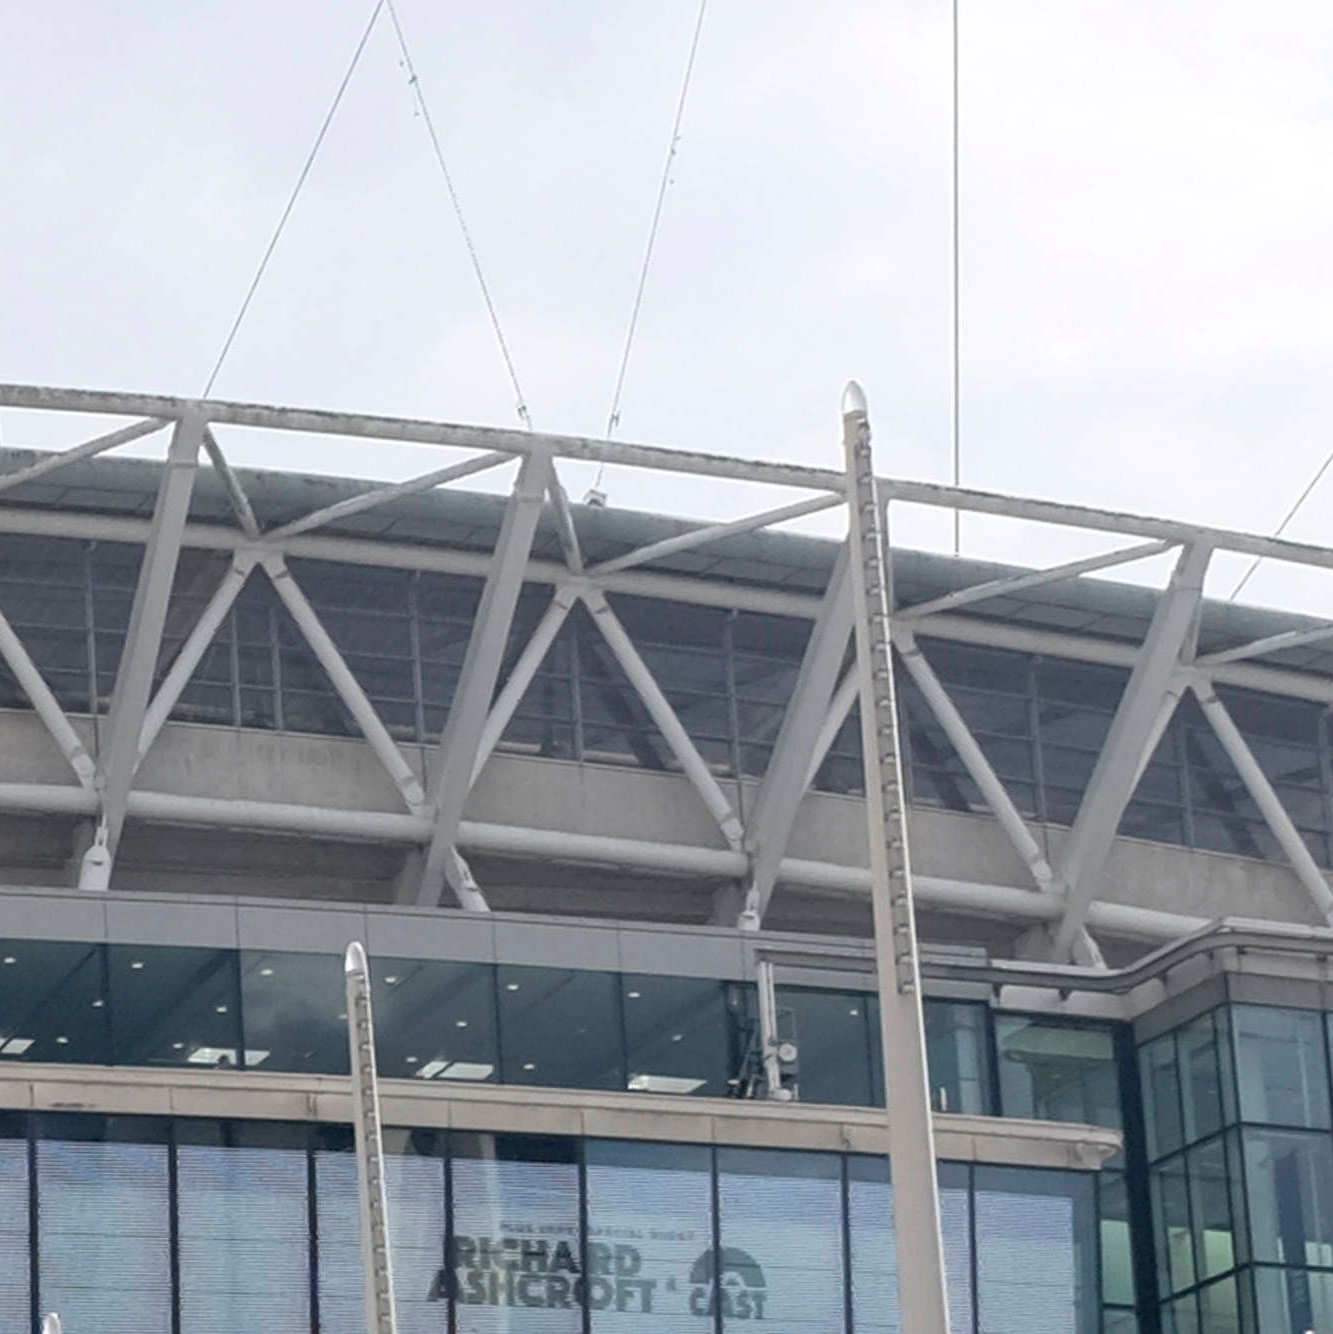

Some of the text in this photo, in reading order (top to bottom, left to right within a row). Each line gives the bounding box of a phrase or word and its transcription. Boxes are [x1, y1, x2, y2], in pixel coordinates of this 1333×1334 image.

[449, 1235, 642, 1277] RICHARD
[427, 1268, 658, 1313] ASHCROFT
[688, 1284, 768, 1319] CAST
